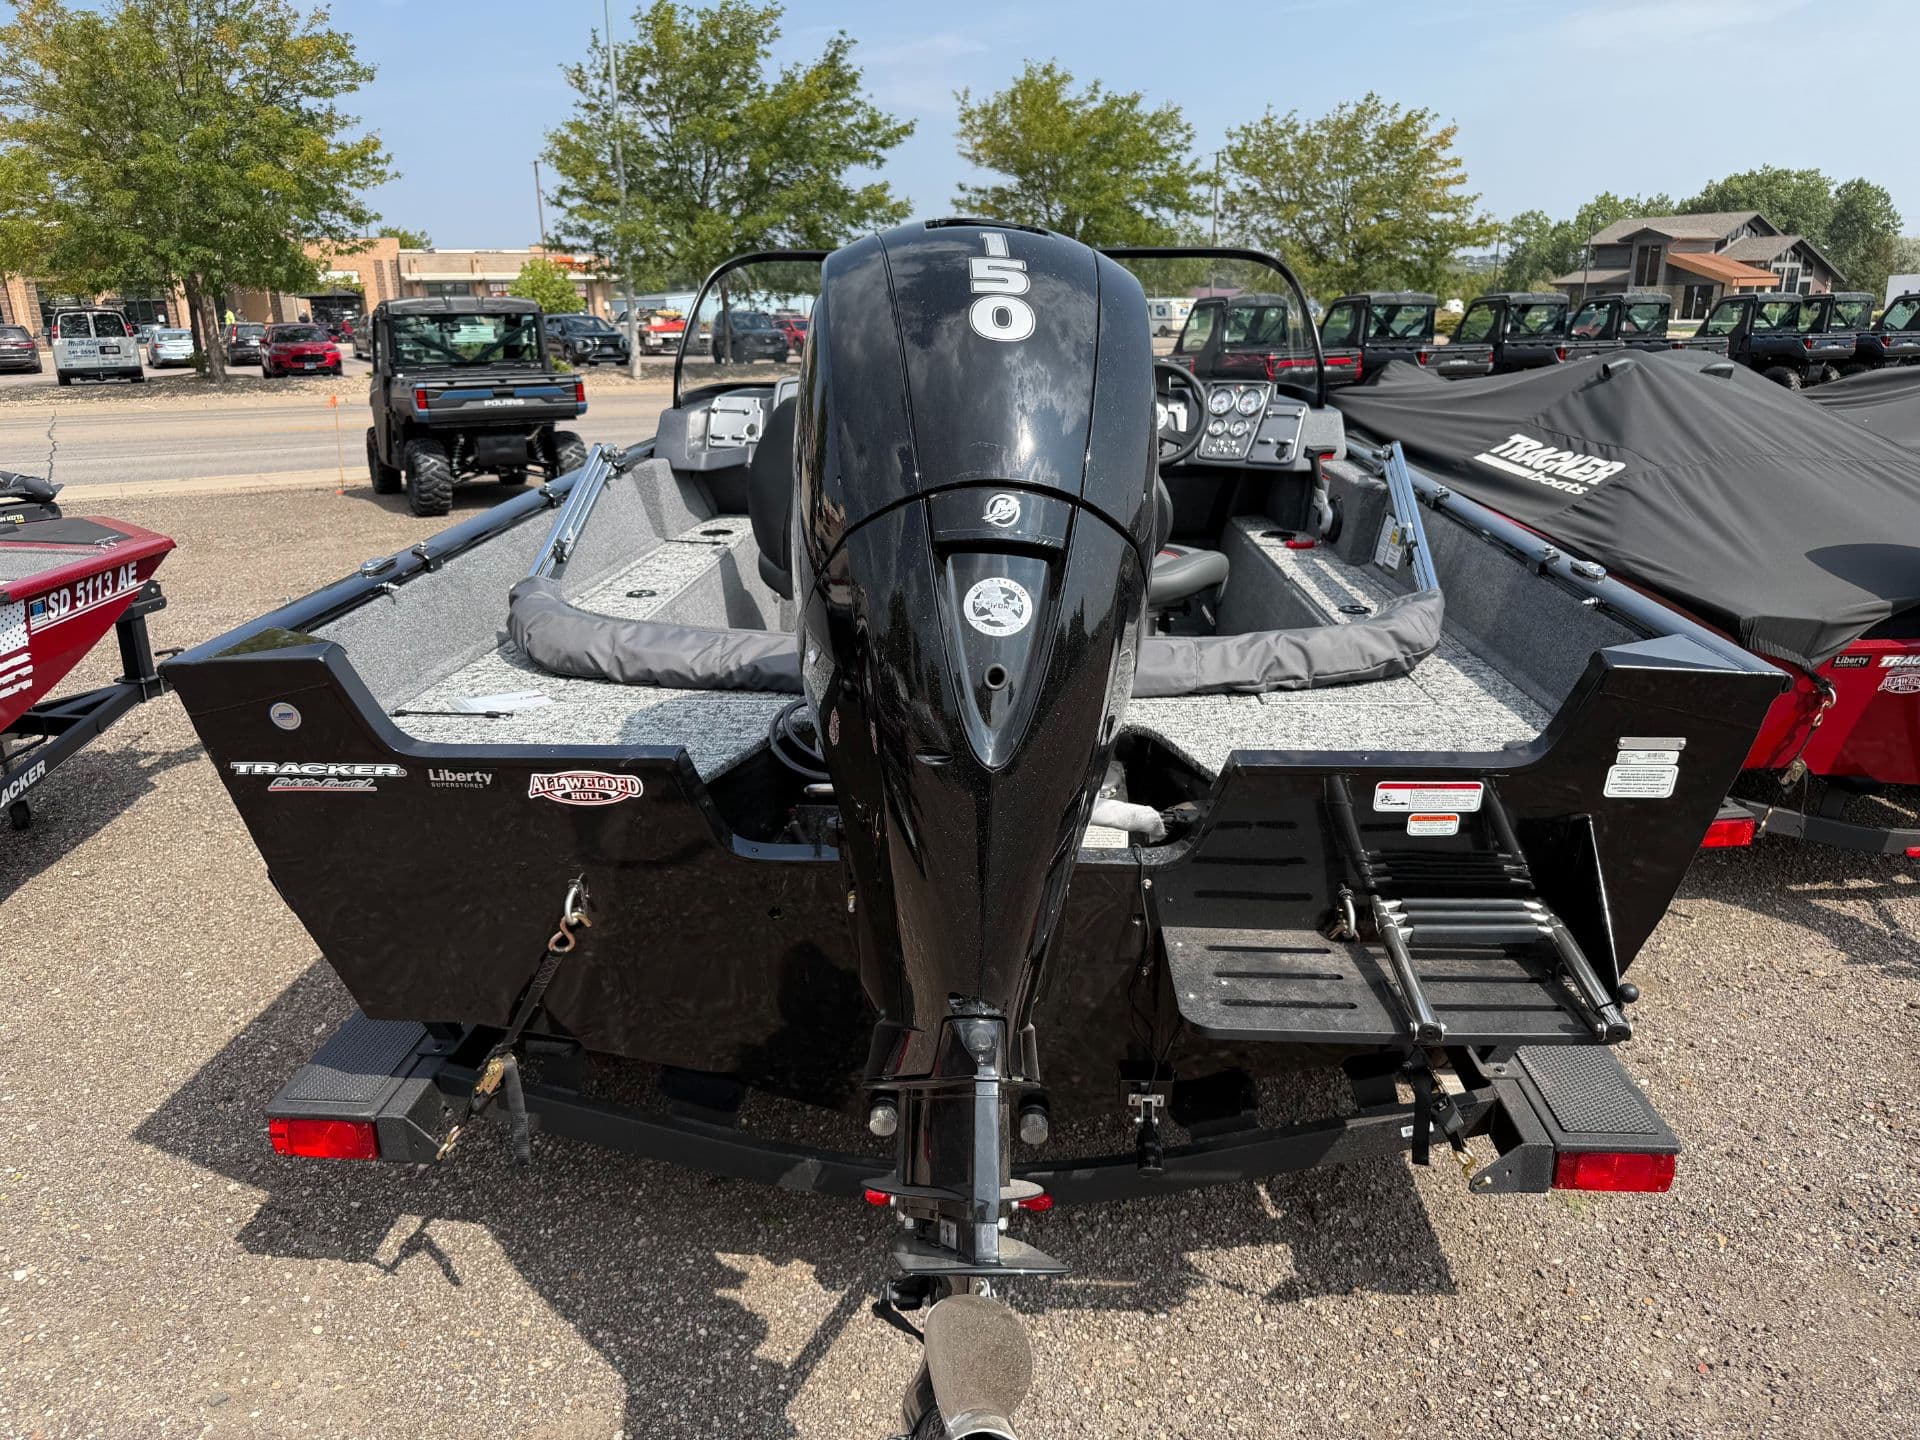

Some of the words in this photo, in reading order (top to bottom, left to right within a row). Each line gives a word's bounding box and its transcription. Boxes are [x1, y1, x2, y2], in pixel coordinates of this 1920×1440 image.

[969, 232, 1036, 342] 150
[484, 398, 525, 407] POLARIS
[1490, 434, 1626, 485] TRACKER
[1528, 471, 1589, 494] boats
[47, 588, 71, 619] SD
[76, 572, 113, 608] 5113
[117, 561, 138, 592] AE
[1836, 656, 1868, 664] Liberty
[231, 762, 402, 776] TRACKER
[428, 769, 493, 785] Liberty
[0, 760, 46, 808] ACKER
[531, 775, 565, 794] ALL
[564, 775, 642, 794] WELDED
[570, 792, 604, 800] HULL
